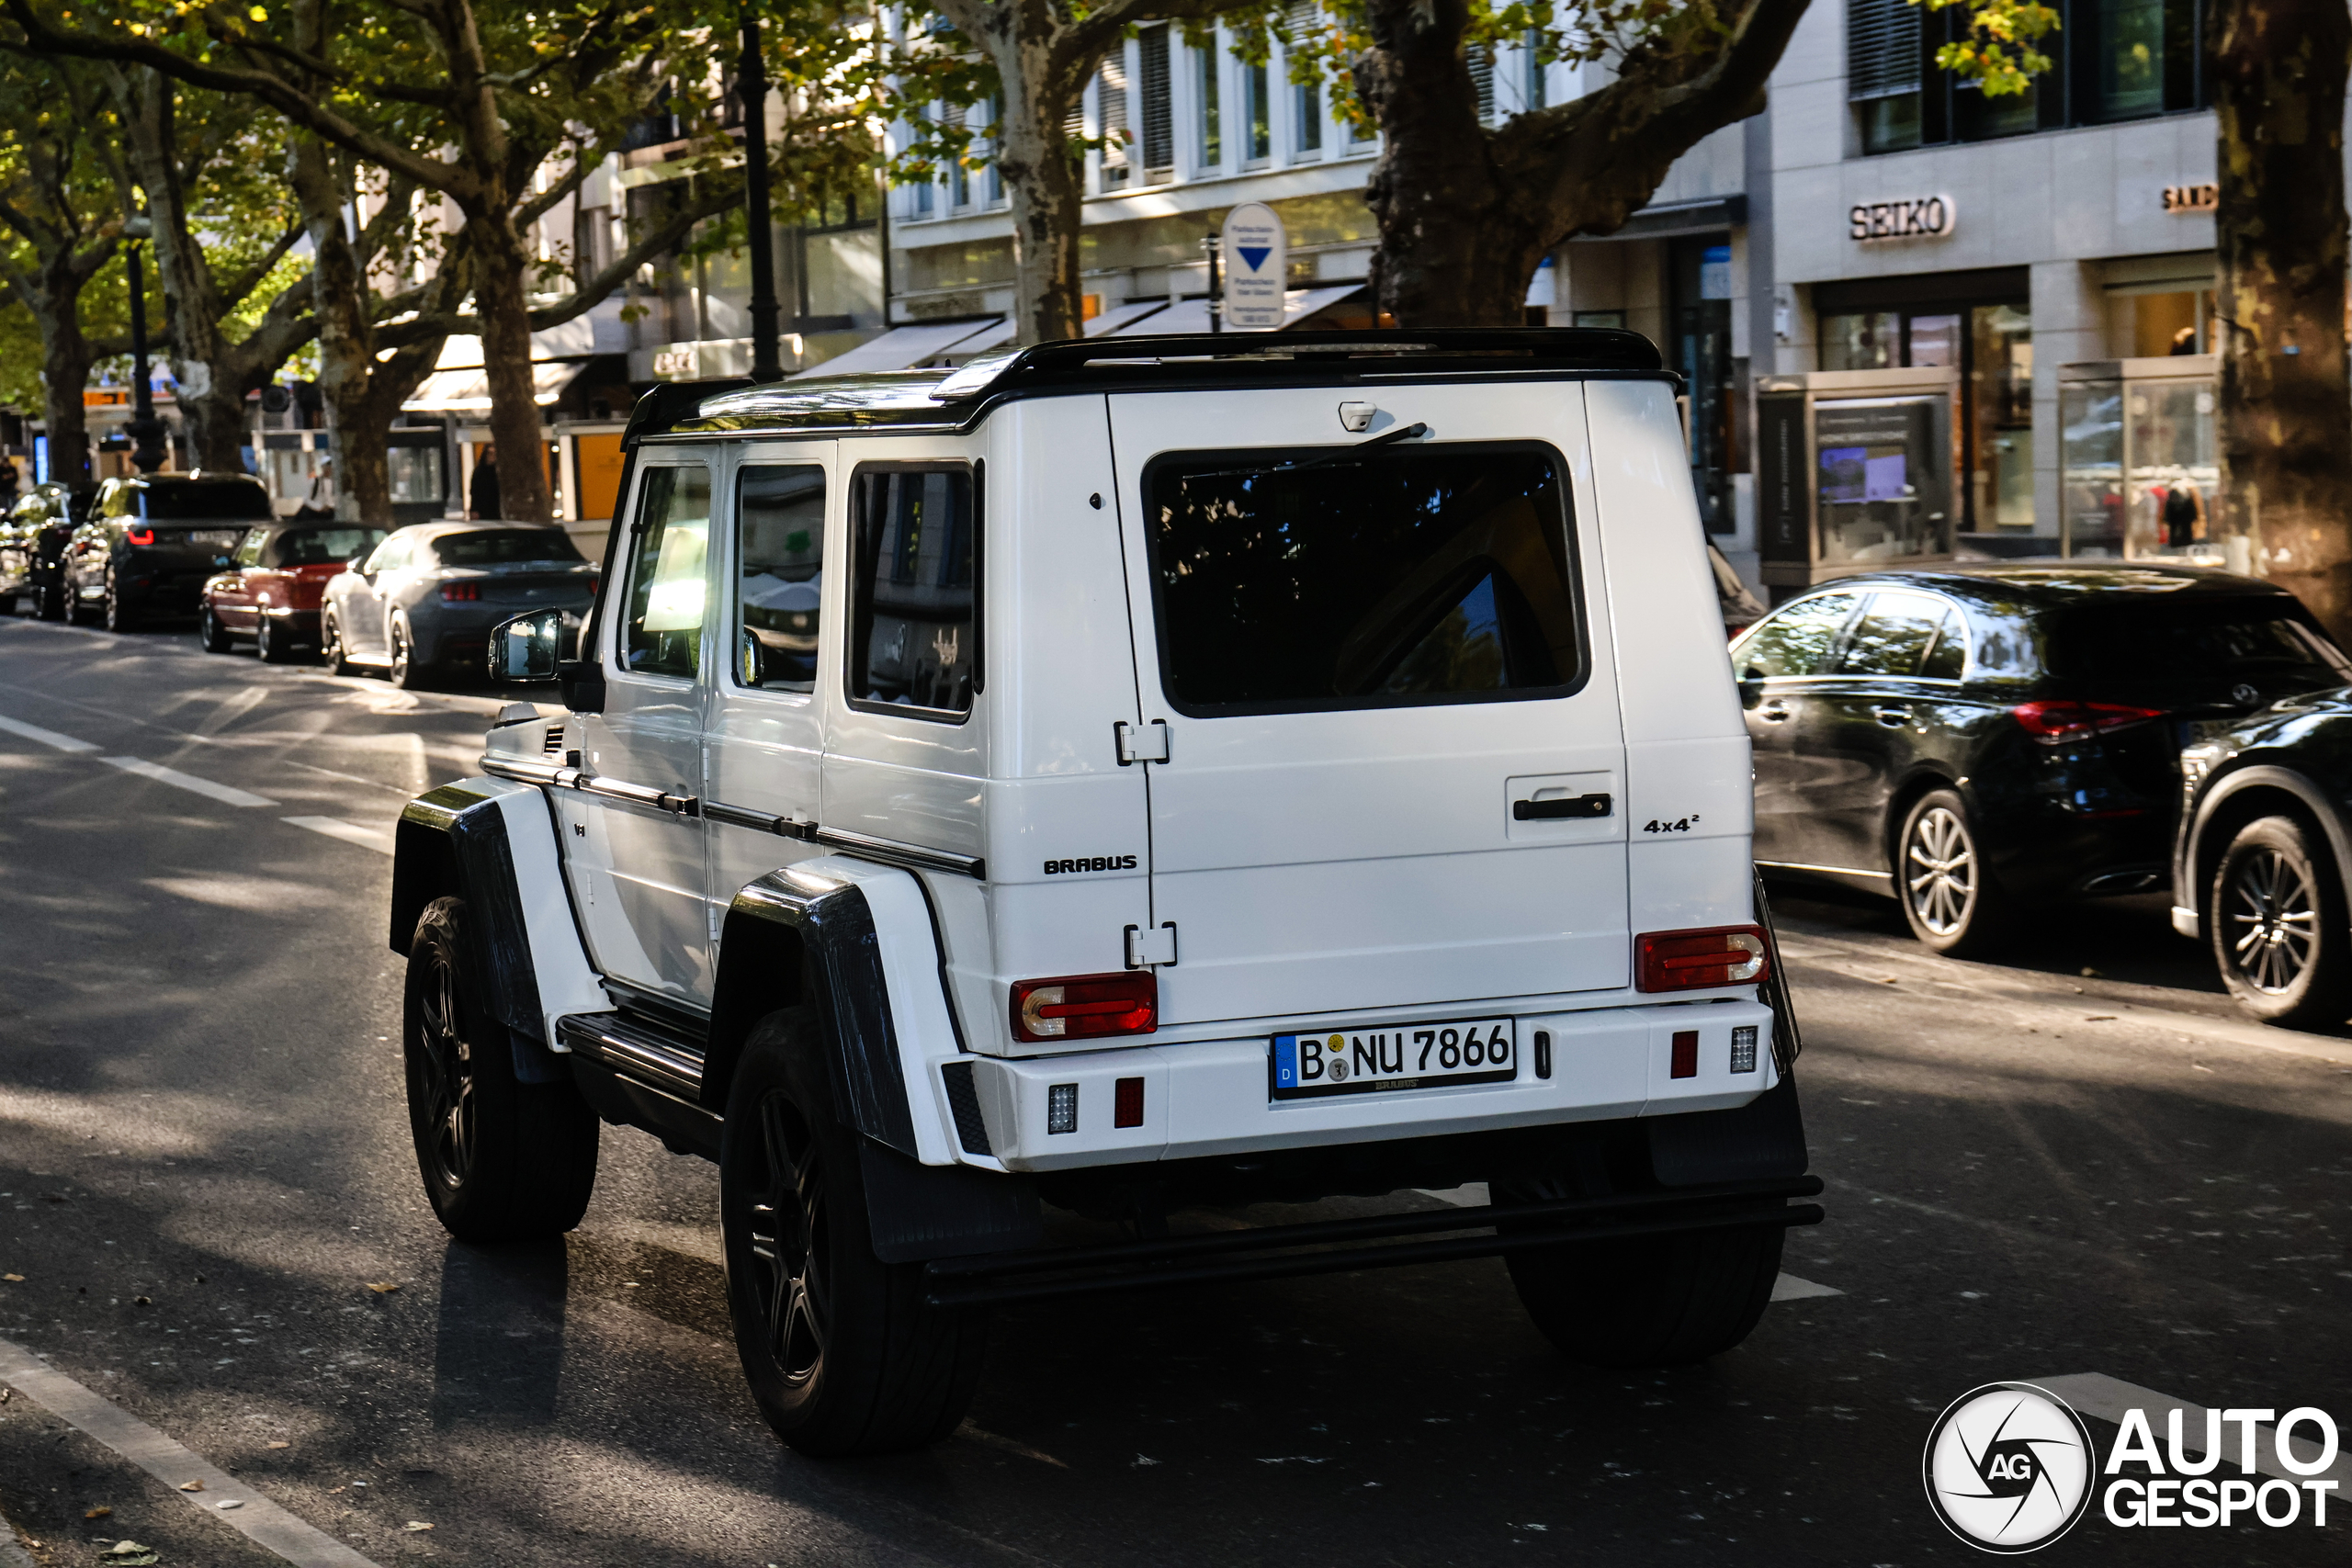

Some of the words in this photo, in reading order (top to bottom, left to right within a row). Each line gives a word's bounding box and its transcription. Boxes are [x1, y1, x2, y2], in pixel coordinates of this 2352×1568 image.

[1849, 196, 1953, 242] SEIKO
[1044, 854, 1137, 875] BRABUS
[1282, 1068, 1291, 1080] D
